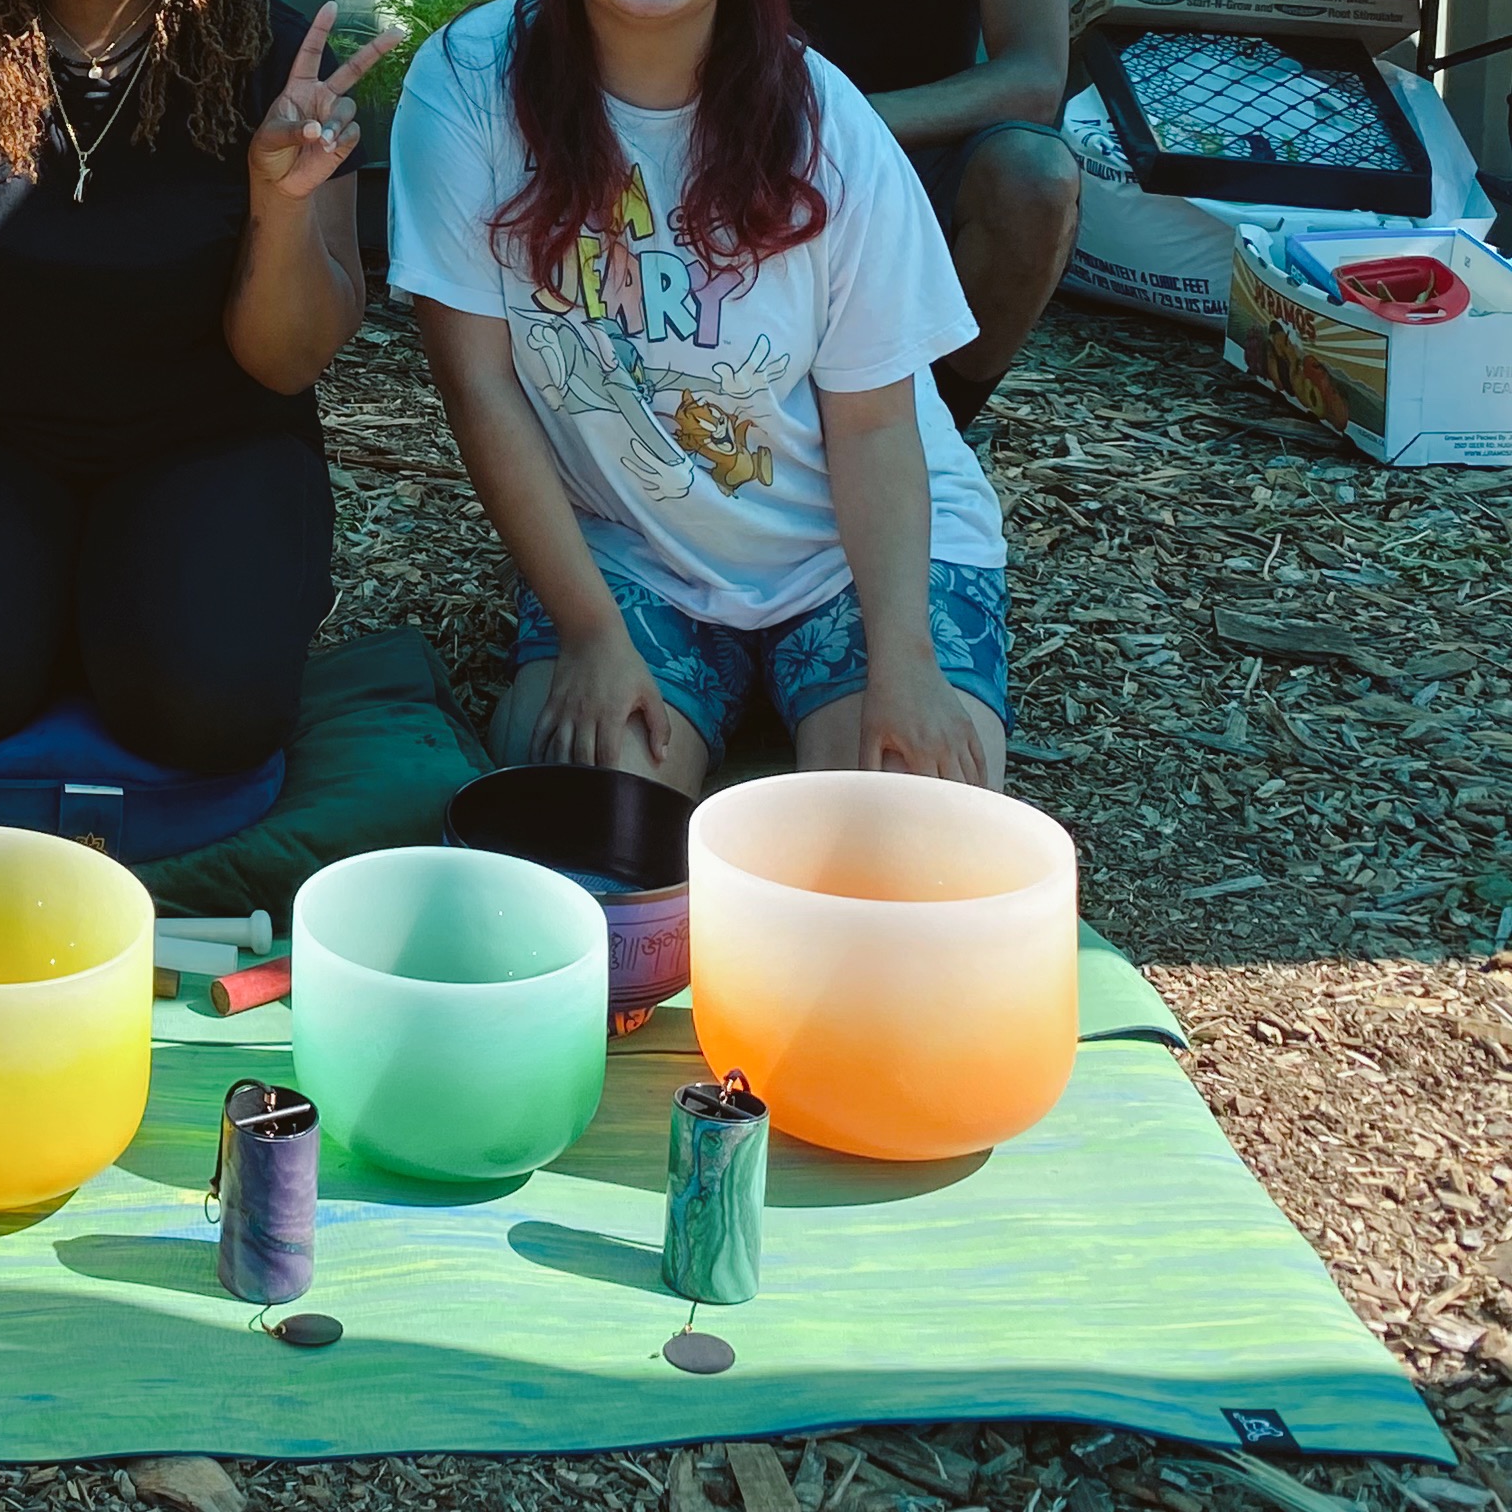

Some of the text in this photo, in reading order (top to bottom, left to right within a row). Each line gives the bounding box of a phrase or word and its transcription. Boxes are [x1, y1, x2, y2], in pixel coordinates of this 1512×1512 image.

[1255, 3, 1273, 13] and
[1149, 273, 1182, 292] CUBIC
[1182, 278, 1210, 295] FEET
